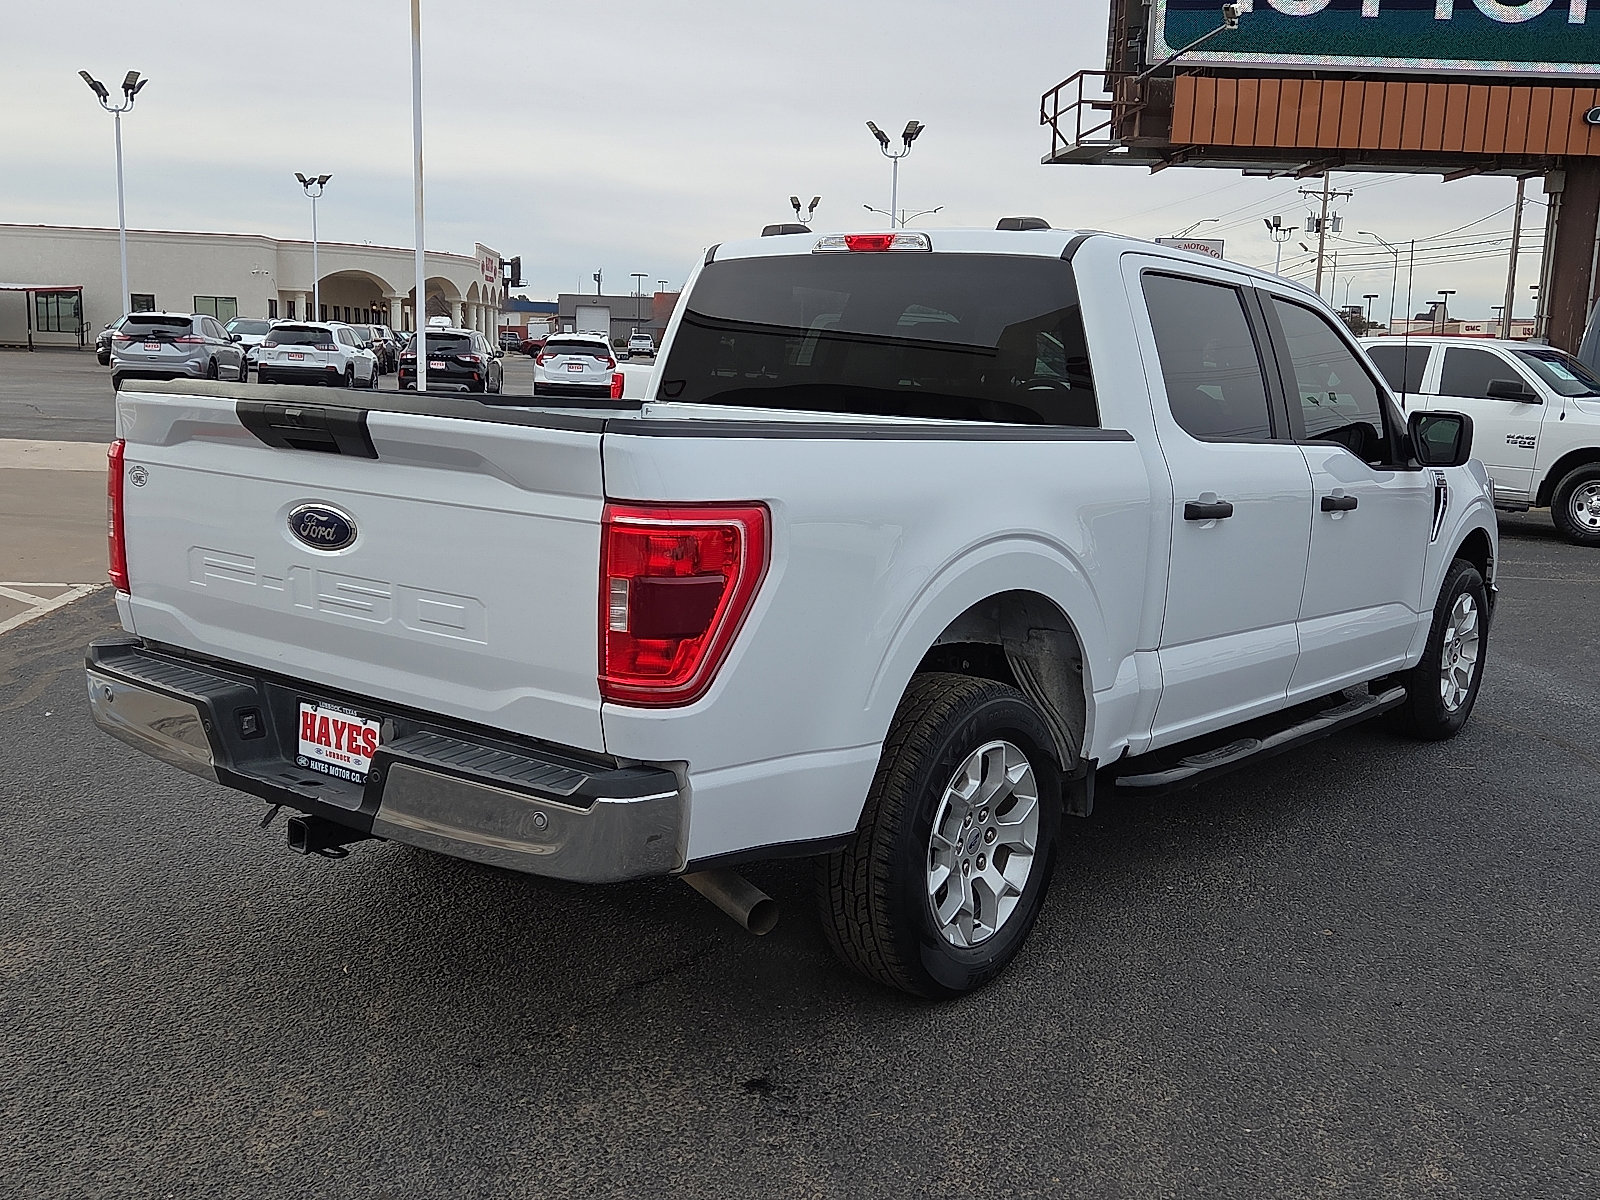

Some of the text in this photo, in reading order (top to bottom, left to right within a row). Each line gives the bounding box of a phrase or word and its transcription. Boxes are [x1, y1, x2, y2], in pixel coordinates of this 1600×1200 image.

[1183, 243, 1210, 253] MOTOR
[300, 512, 338, 541] Ford
[187, 545, 488, 646] F-150
[301, 710, 378, 759] HAYES
[325, 749, 351, 764] LUBBOCK
[310, 760, 362, 784] HAYES MOTOR CO.
